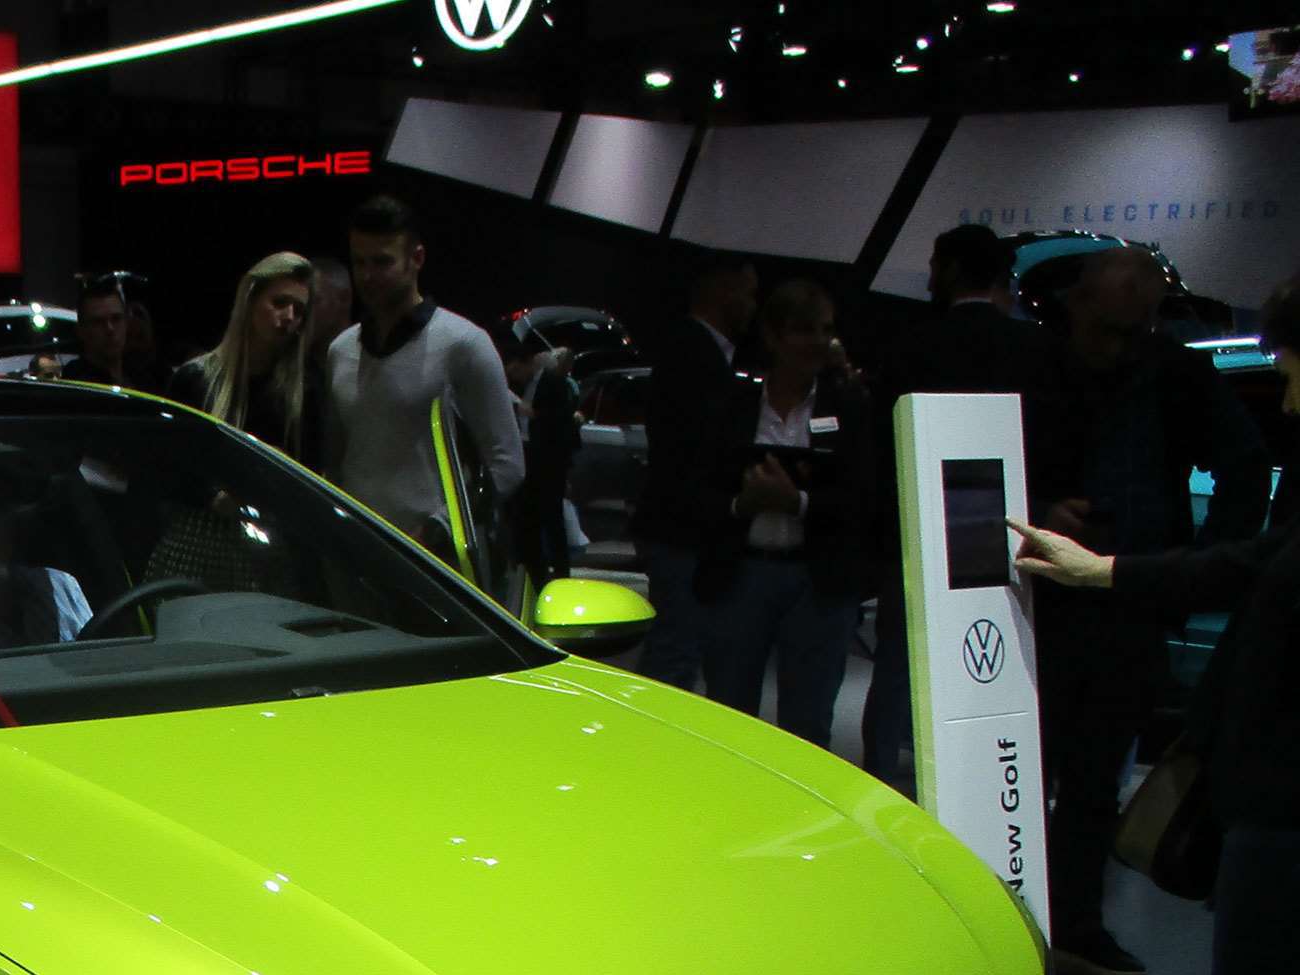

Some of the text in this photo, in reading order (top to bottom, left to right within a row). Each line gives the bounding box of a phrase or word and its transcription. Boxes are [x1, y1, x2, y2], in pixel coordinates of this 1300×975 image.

[435, 0, 531, 51] W
[118, 150, 373, 187] PORSCHE
[957, 200, 1281, 225] SOUL ELECTRIFIED
[997, 737, 1020, 813] Golf
